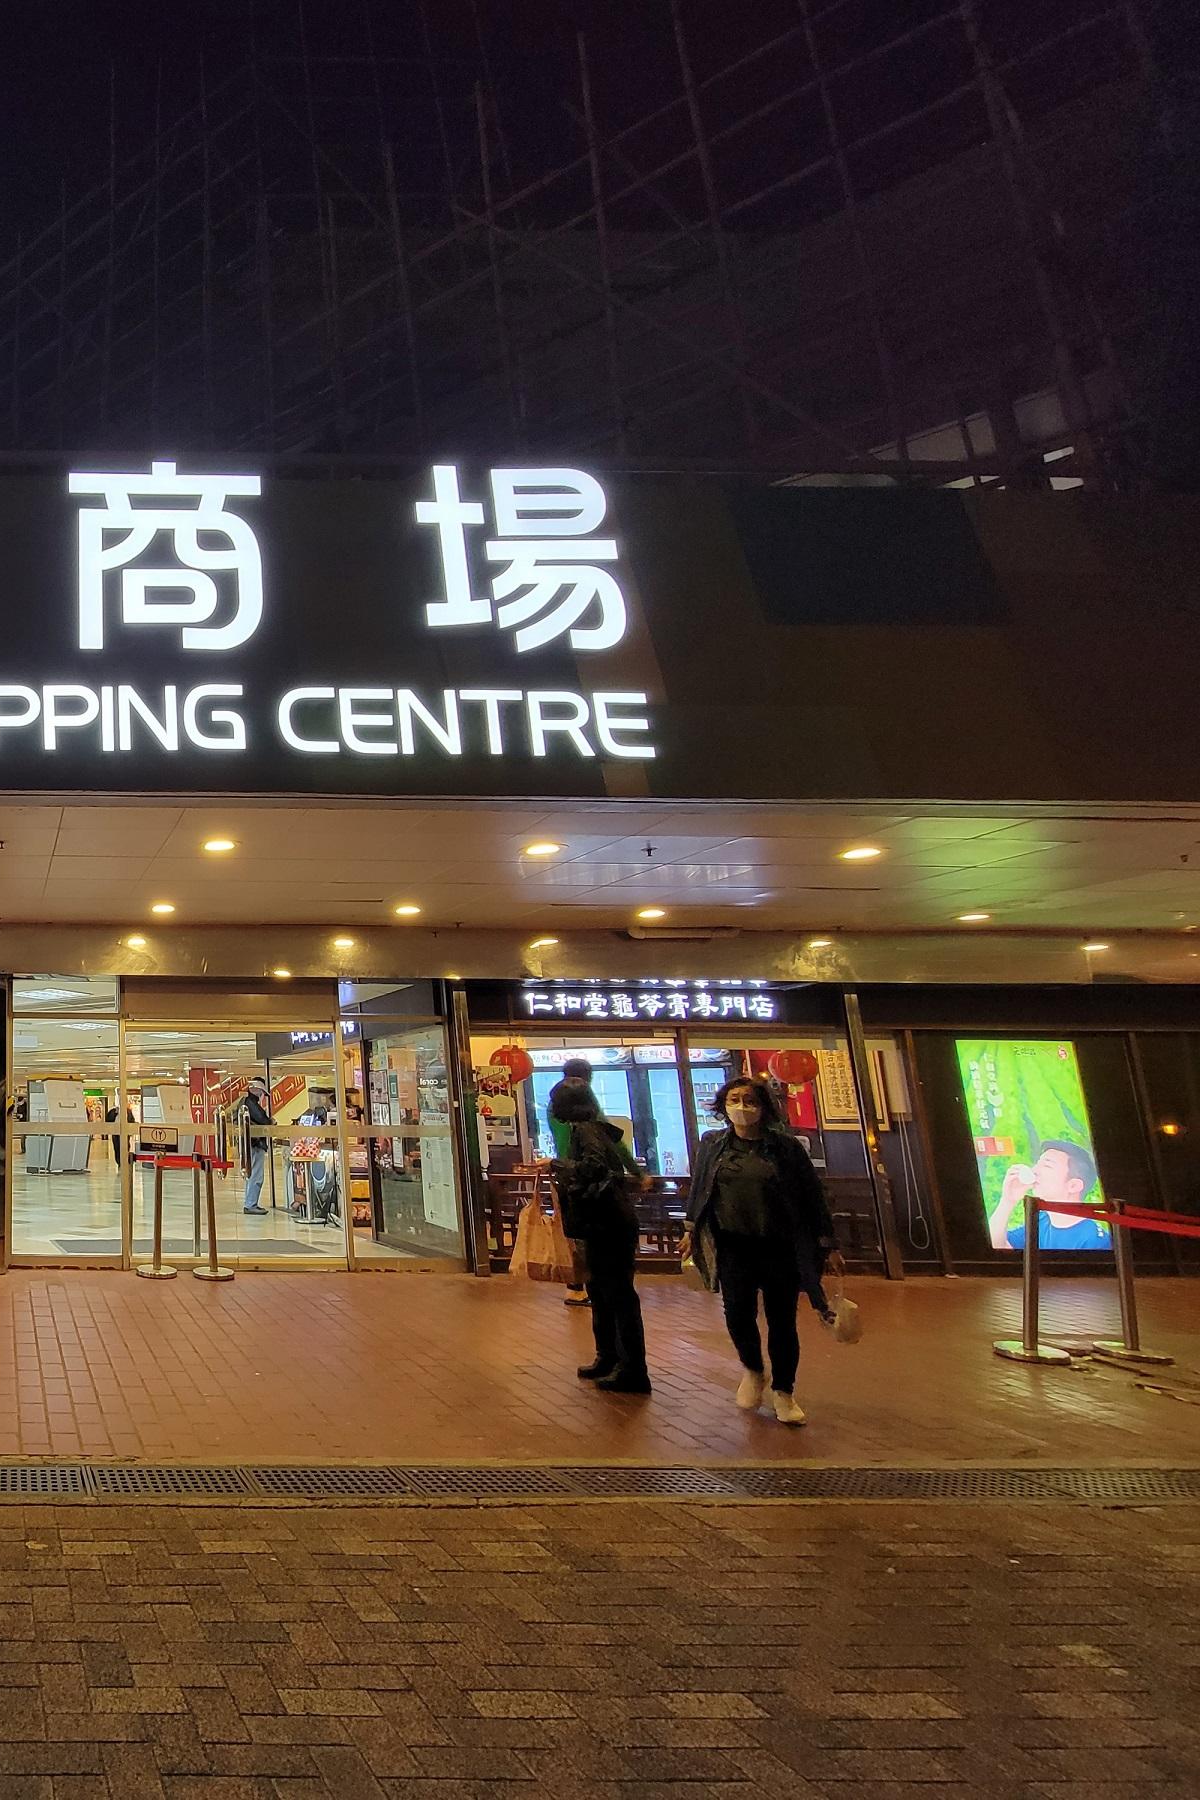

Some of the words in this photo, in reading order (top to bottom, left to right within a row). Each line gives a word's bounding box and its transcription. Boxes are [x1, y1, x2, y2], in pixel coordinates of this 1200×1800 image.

[278, 687, 656, 757] CENTRE
[524, 992, 775, 1019] 仁和堂龜苓膏專門店
